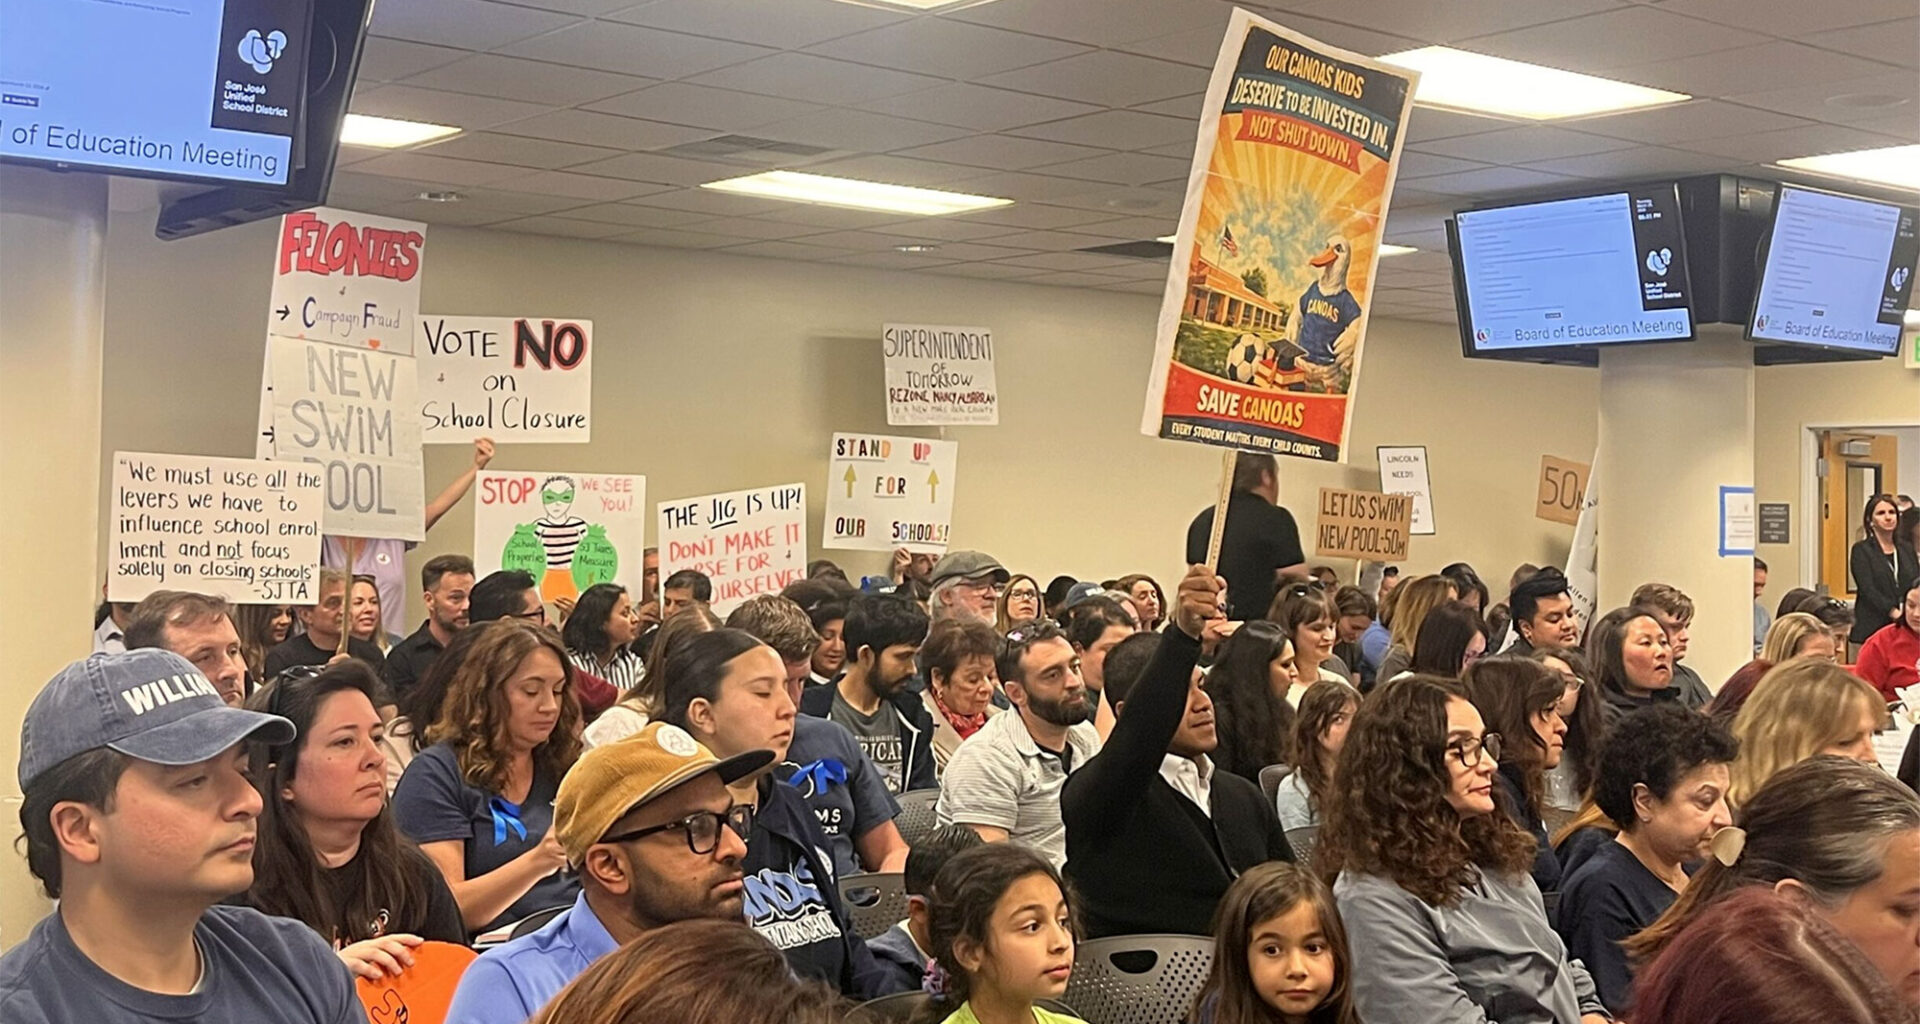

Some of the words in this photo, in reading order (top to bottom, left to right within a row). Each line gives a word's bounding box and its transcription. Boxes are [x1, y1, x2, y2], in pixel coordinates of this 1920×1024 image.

[1265, 45, 1289, 73] OUR
[1288, 51, 1334, 89] CANOAS
[1333, 68, 1365, 99] KIDS
[224, 90, 255, 103] Unified
[225, 80, 242, 91] San
[223, 100, 254, 112] School
[255, 104, 288, 117] District
[1231, 77, 1286, 110] DESERVE
[1285, 90, 1299, 112] TO
[1299, 94, 1312, 115] BE
[1311, 95, 1371, 140] INVESTED
[12, 124, 39, 146] of
[47, 125, 173, 160] Education
[182, 141, 278, 177] Meeting
[1248, 114, 1277, 139] NOT
[1276, 121, 1310, 148] SHUT
[1308, 129, 1351, 165] DOWN.
[280, 212, 424, 282] FELONIES
[363, 303, 401, 329] Fraud
[1306, 299, 1339, 324] CANOAS
[1515, 327, 1549, 341] Board
[1553, 326, 1565, 339] of
[1568, 322, 1629, 338] Education
[1632, 319, 1684, 334] Meeting
[1784, 321, 1810, 337] Board
[1811, 325, 1821, 338] of
[1822, 325, 1863, 343] Education
[1865, 330, 1896, 349] Meeting
[423, 319, 500, 358] VOTE
[513, 319, 588, 371] NO
[306, 345, 396, 401] NEW
[906, 370, 973, 389] TOMORROW
[931, 362, 946, 374] OF
[483, 375, 516, 392] on
[422, 396, 492, 431] School
[501, 396, 586, 431] Closure
[1196, 383, 1241, 417] SAVE
[1241, 396, 1306, 429] CANOAS
[836, 438, 891, 459] STAND
[912, 442, 932, 461] UP
[1171, 422, 1192, 435] EVERY
[1193, 425, 1225, 441] STUDENT
[1252, 435, 1272, 449] EVERY
[1272, 439, 1292, 452] CHILD
[165, 466, 213, 485] must
[223, 472, 258, 488] use
[265, 470, 287, 488] all
[297, 471, 321, 488] the
[303, 457, 396, 514] OOL
[581, 478, 600, 491] WE
[603, 478, 633, 493] SEE
[875, 476, 906, 495] FOR
[120, 487, 178, 509] levers
[188, 493, 213, 509] we
[222, 491, 263, 513] have
[279, 496, 297, 512] to
[481, 477, 536, 504] STOP
[600, 495, 633, 512] YOU!
[663, 503, 699, 530] THE
[707, 498, 737, 524] JIG
[747, 493, 763, 515] IS
[771, 487, 801, 510] UP!
[1322, 491, 1348, 517] LET
[1350, 494, 1366, 519] US
[120, 514, 203, 535] influence
[213, 517, 270, 536] school
[835, 517, 866, 538] OUR
[891, 521, 949, 542] SCHOOLS!
[1319, 524, 1349, 550] NEW
[120, 540, 167, 560] lment
[178, 540, 210, 559] and
[216, 540, 243, 560] not
[251, 540, 289, 560] focus
[511, 538, 538, 548] School
[669, 535, 715, 562] DON'T
[725, 526, 776, 555] MAKE
[785, 523, 799, 546] IT
[118, 561, 165, 583] solely
[174, 563, 191, 576] on
[199, 561, 255, 585] closing
[579, 555, 615, 567] Measure
[736, 552, 772, 573] FOR
